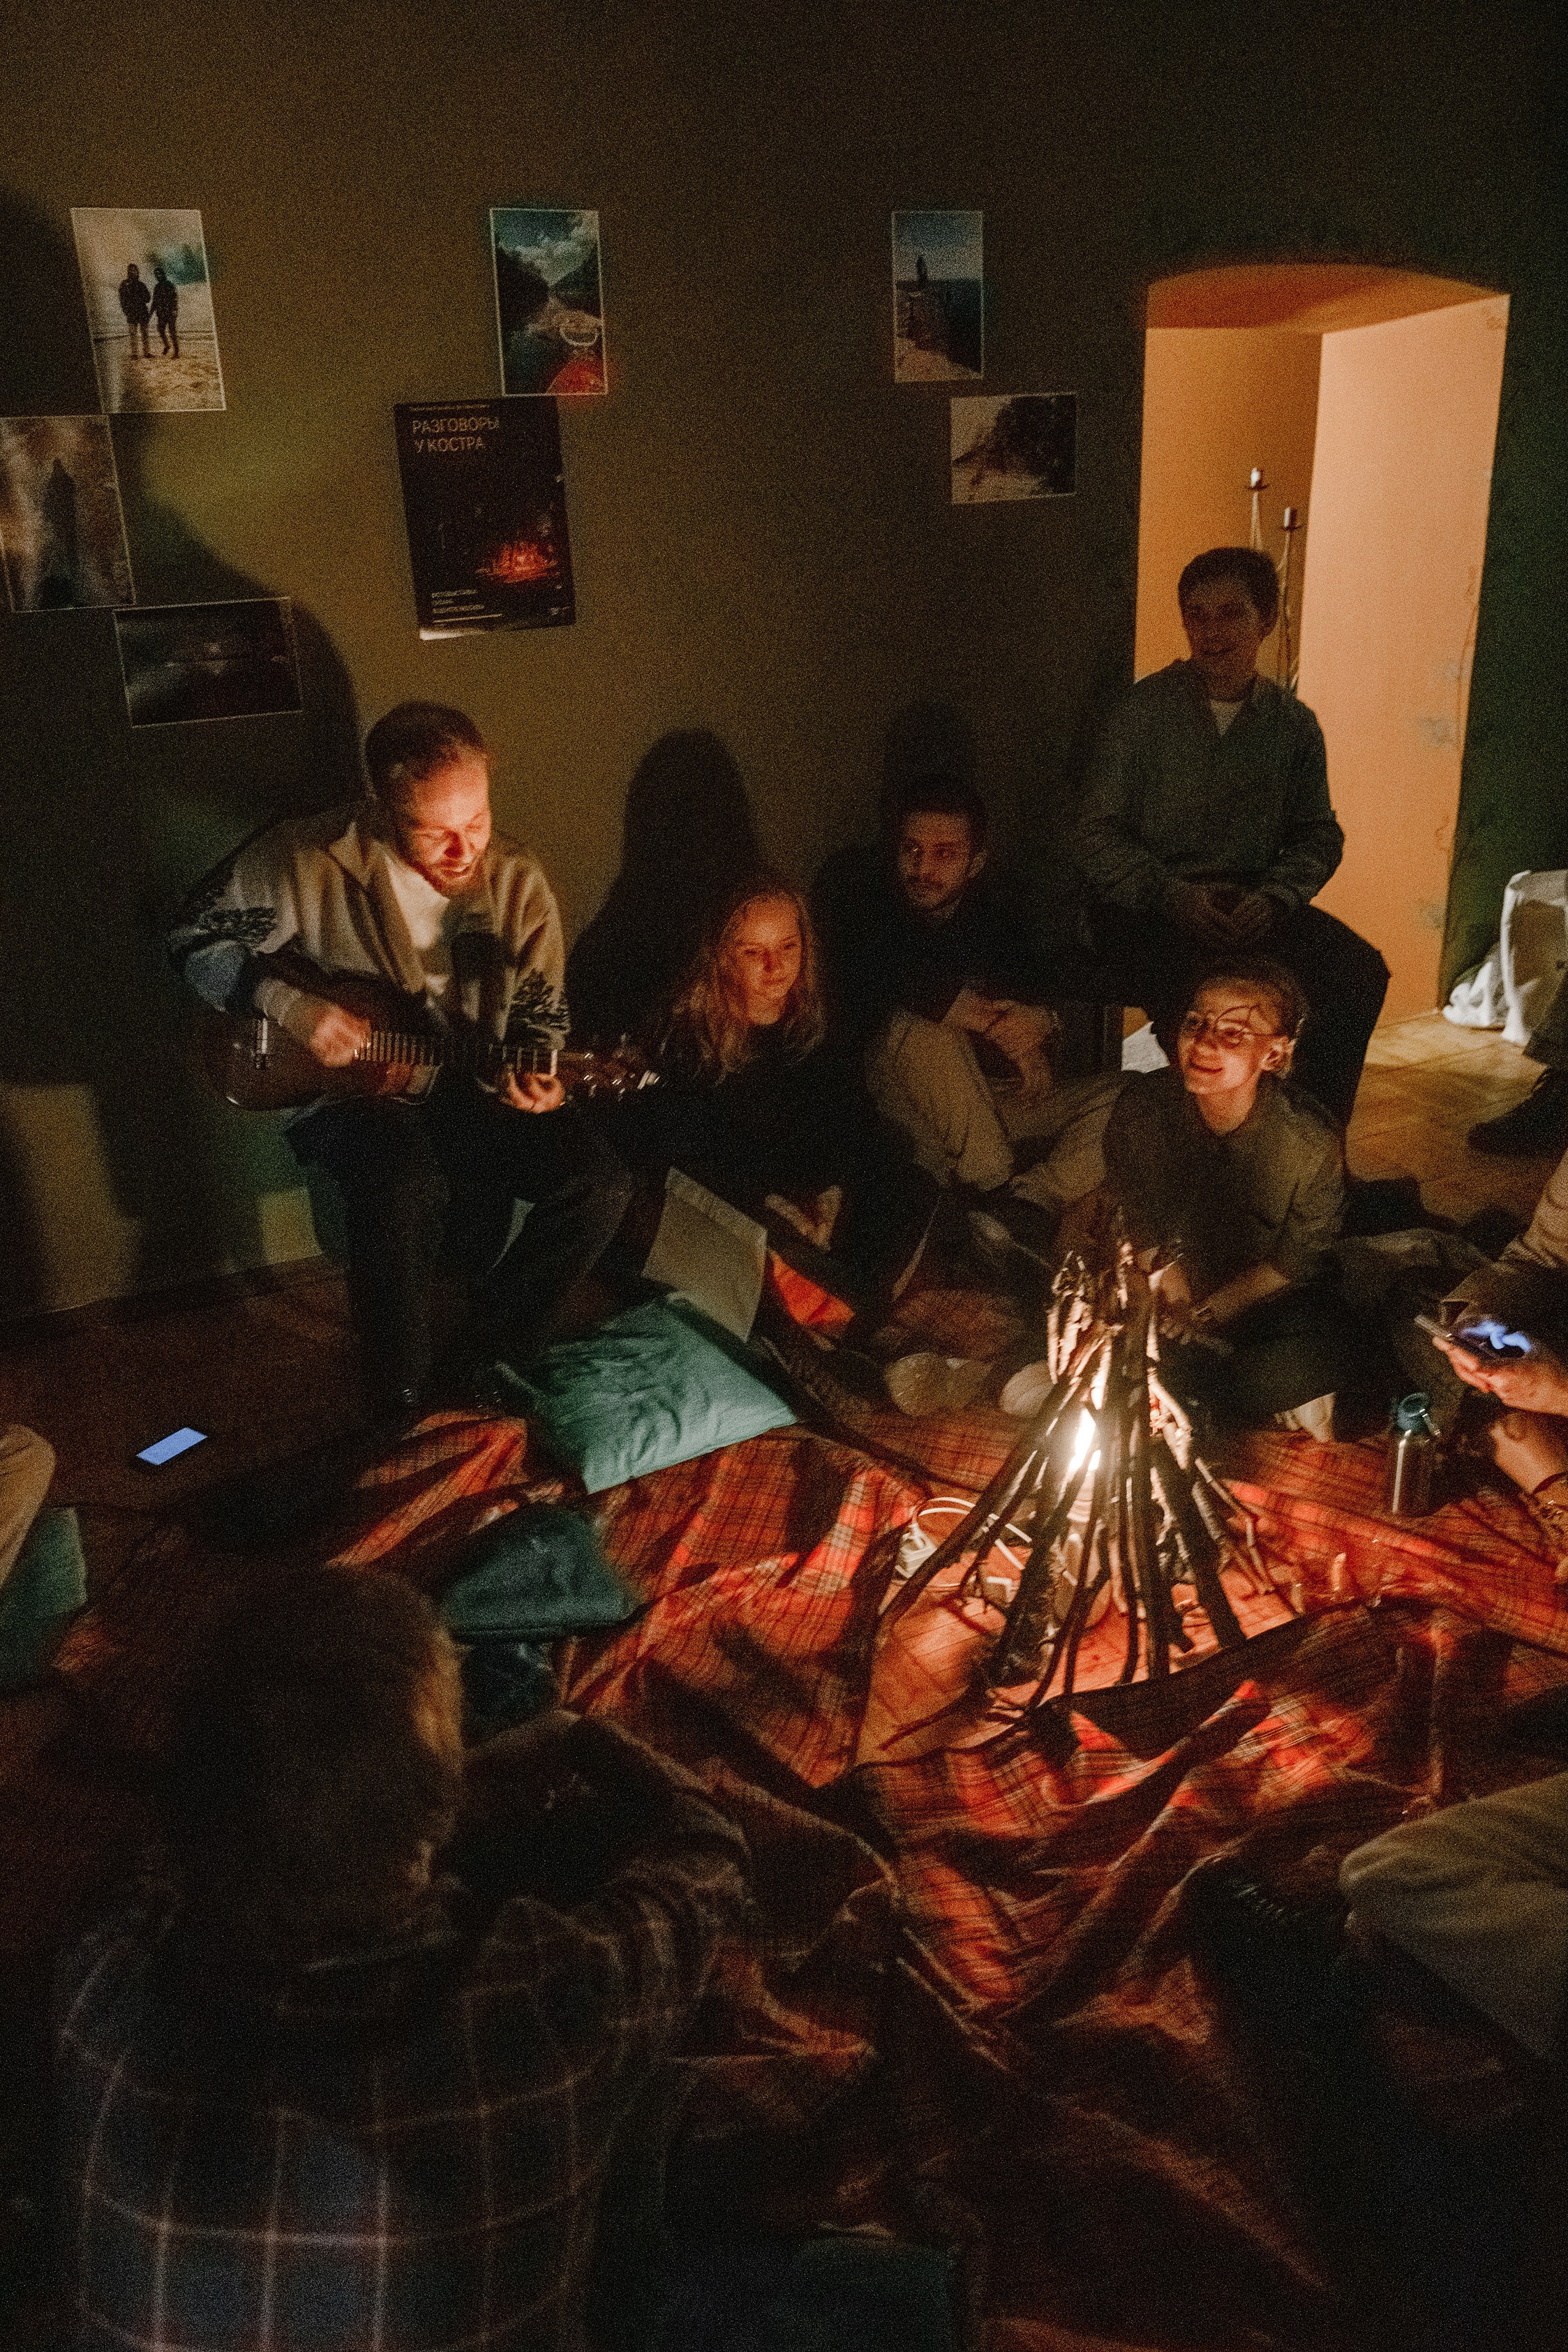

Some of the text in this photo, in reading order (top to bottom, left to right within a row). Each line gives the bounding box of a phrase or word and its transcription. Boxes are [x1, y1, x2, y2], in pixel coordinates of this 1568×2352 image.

[412, 417, 499, 434] РАЗГОВОРЫ
[414, 436, 484, 453] У КОСТРА
